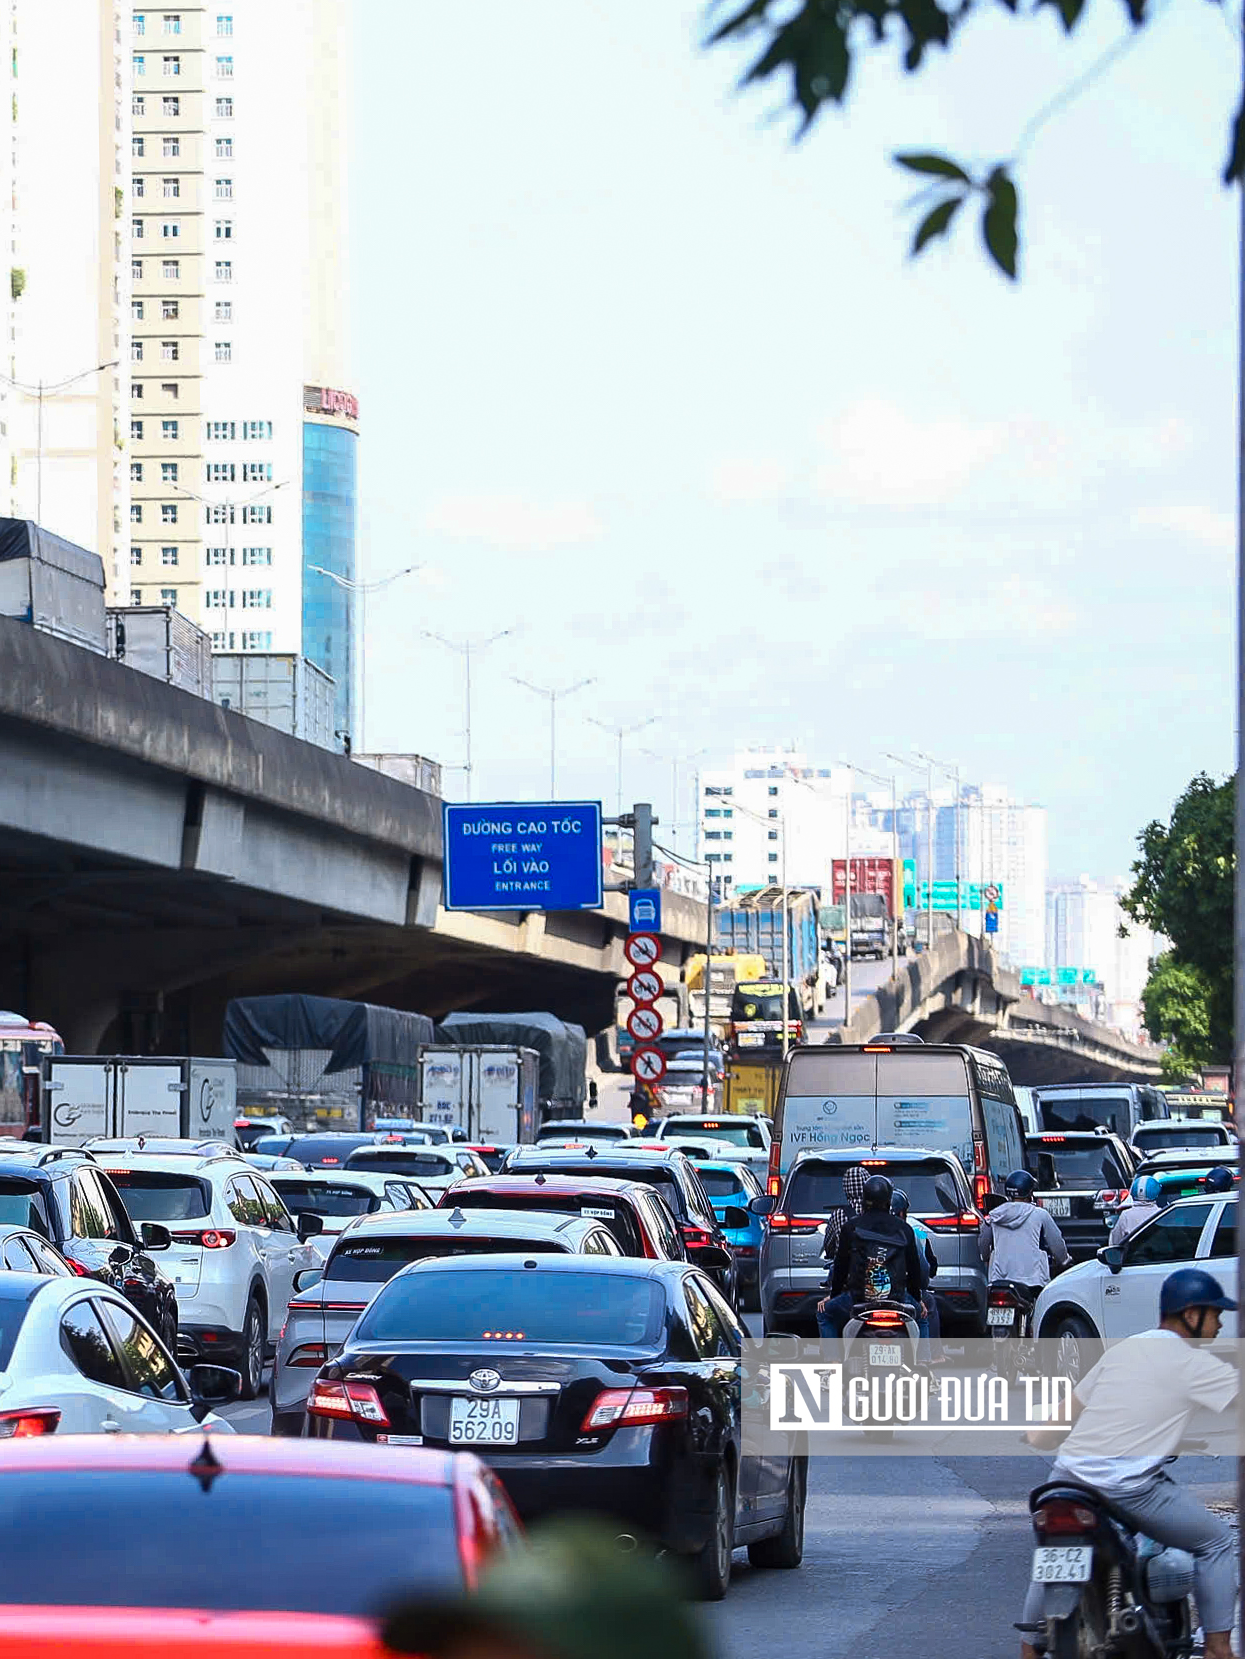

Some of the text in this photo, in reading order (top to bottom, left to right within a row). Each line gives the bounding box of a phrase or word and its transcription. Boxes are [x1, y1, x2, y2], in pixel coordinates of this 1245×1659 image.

[463, 815, 582, 835] ĐƯỜNG CAO TỐC
[491, 843, 543, 853] FREE WAY
[494, 857, 550, 874] LỐI VÀO
[495, 881, 551, 891] ENTRANCE
[790, 1133, 806, 1142] IVF
[841, 1132, 870, 1143] Ngọc
[467, 1399, 501, 1418] 29A
[452, 1421, 515, 1440] 562.09
[1042, 1548, 1083, 1562] 36-C2
[1036, 1564, 1087, 1579] 302.41
